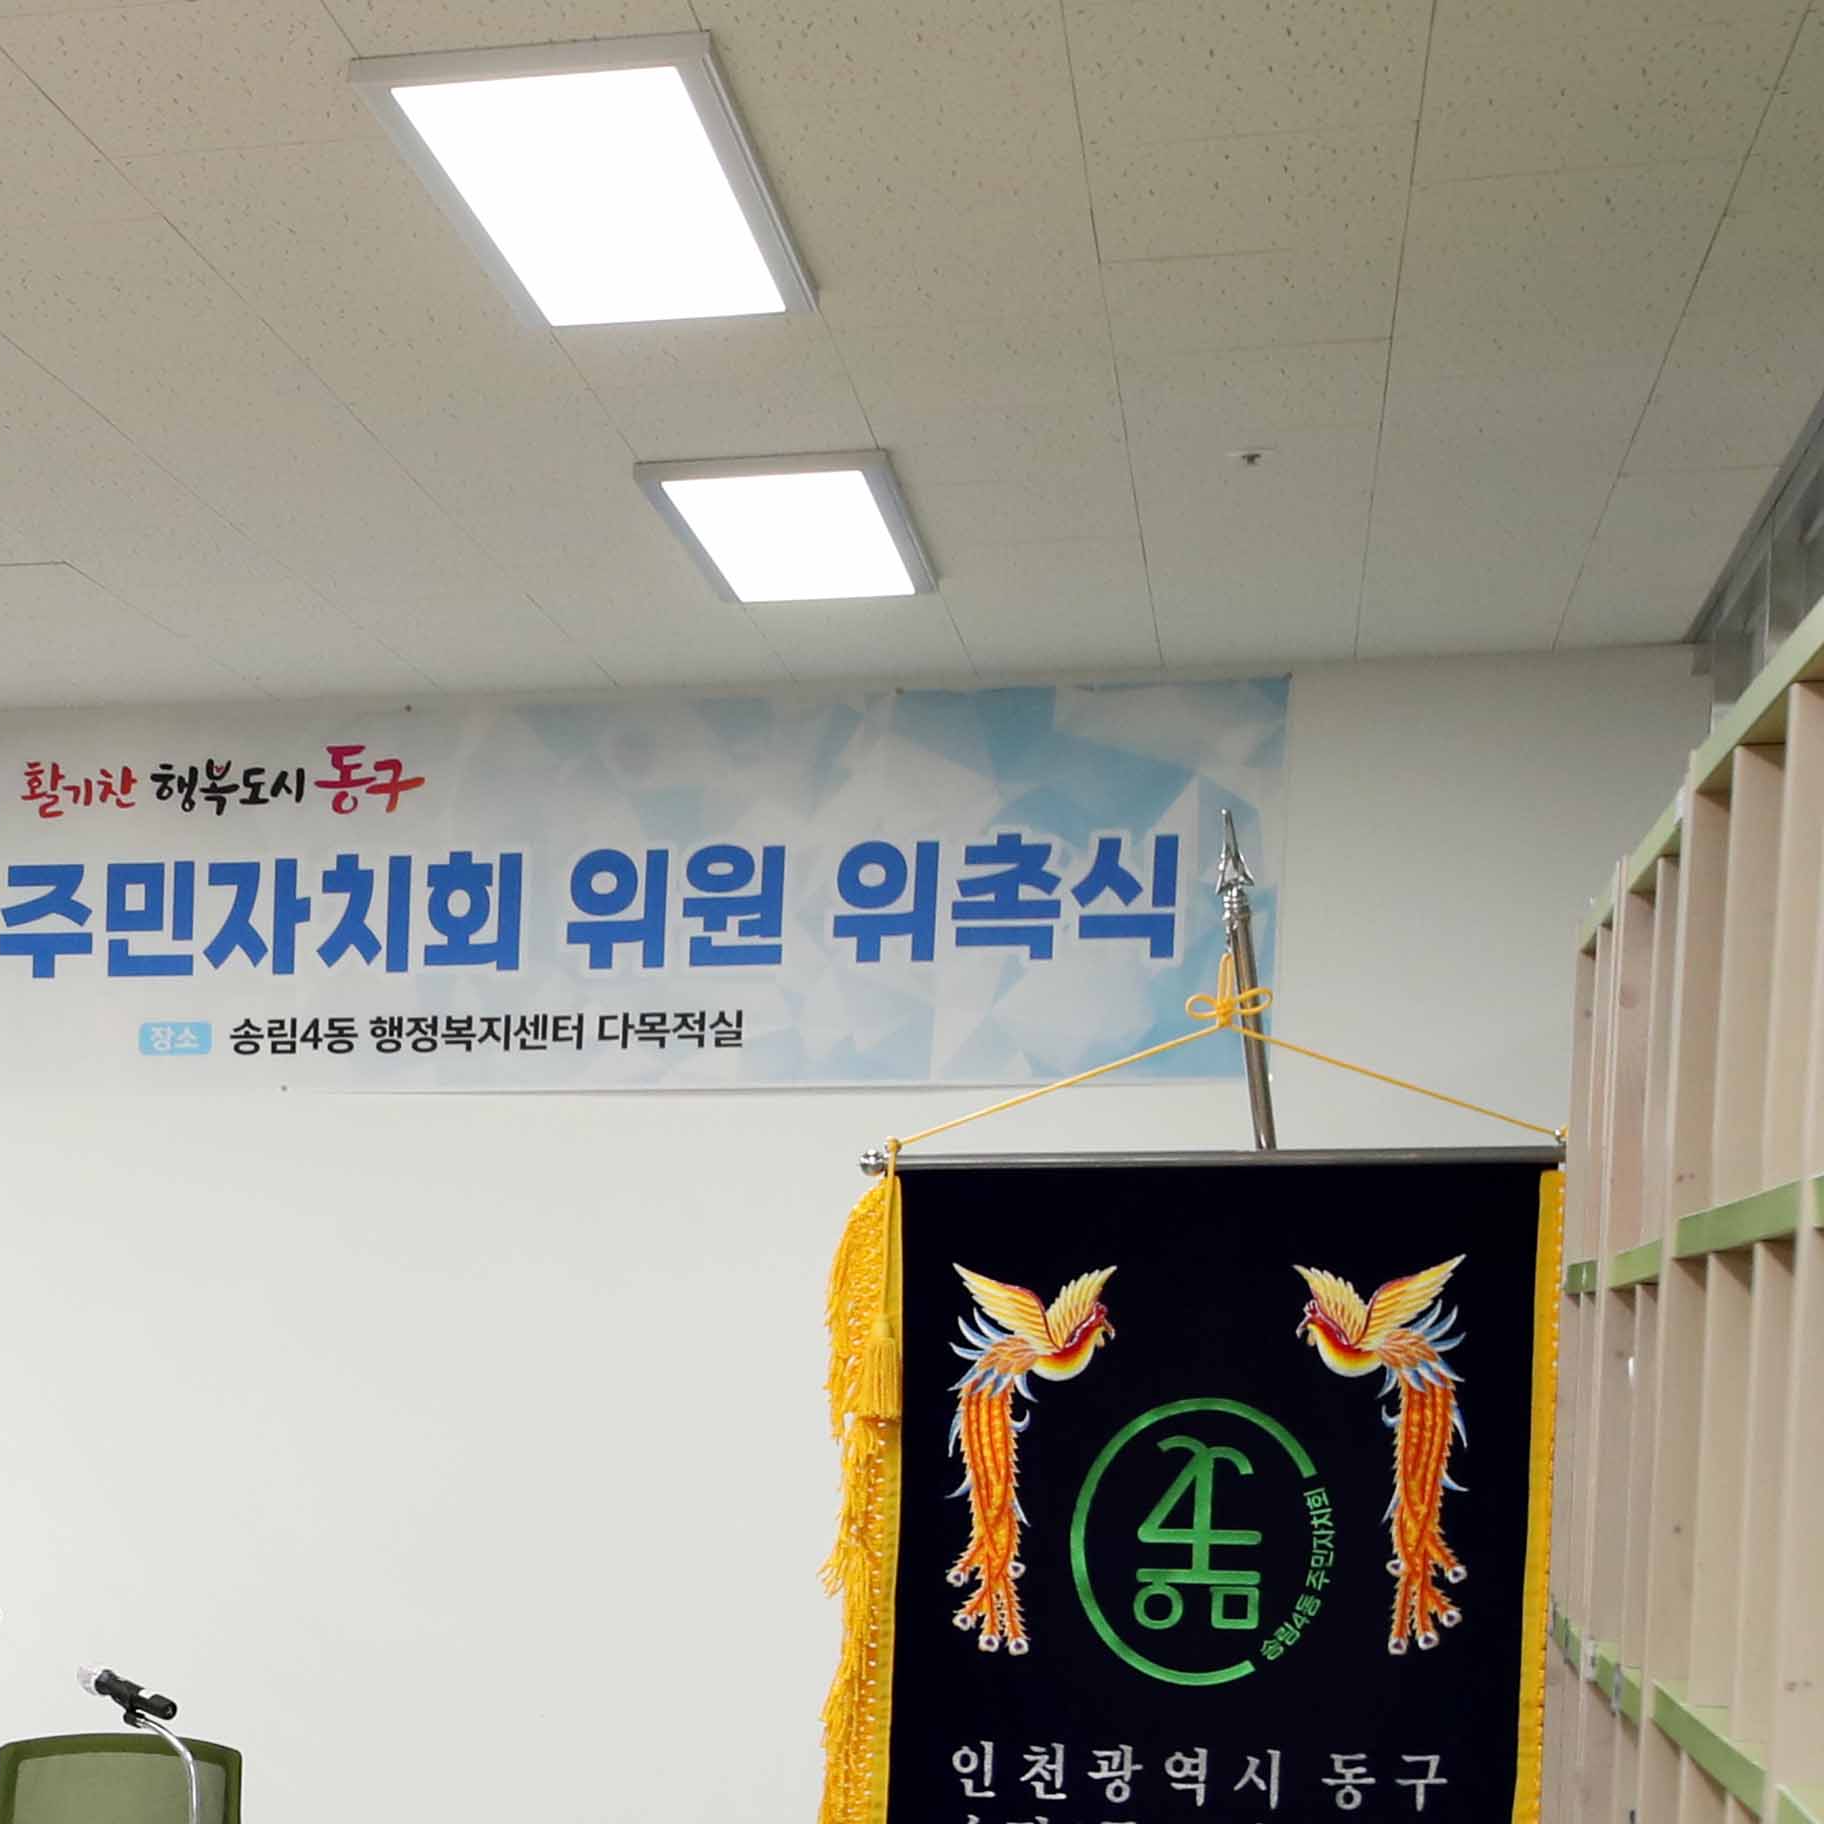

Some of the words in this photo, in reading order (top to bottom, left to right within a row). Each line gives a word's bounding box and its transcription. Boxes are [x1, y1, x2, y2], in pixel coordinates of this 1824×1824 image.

[20, 761, 139, 819] 활기찬
[149, 757, 306, 817] 행복도시
[313, 744, 426, 815] 동구
[566, 843, 786, 970] 위원
[832, 833, 1180, 963] 위촉식
[150, 1026, 201, 1052] 장소
[229, 1017, 359, 1056] 송림4동
[369, 1012, 584, 1054] 행정복지센터
[597, 1009, 744, 1050] 다목적실
[1259, 1594, 1322, 1662] 송림4동
[1303, 1486, 1336, 1592] 주민자치회
[951, 1740, 1281, 1810] 인천광역시
[1321, 1753, 1448, 1812] 동구
